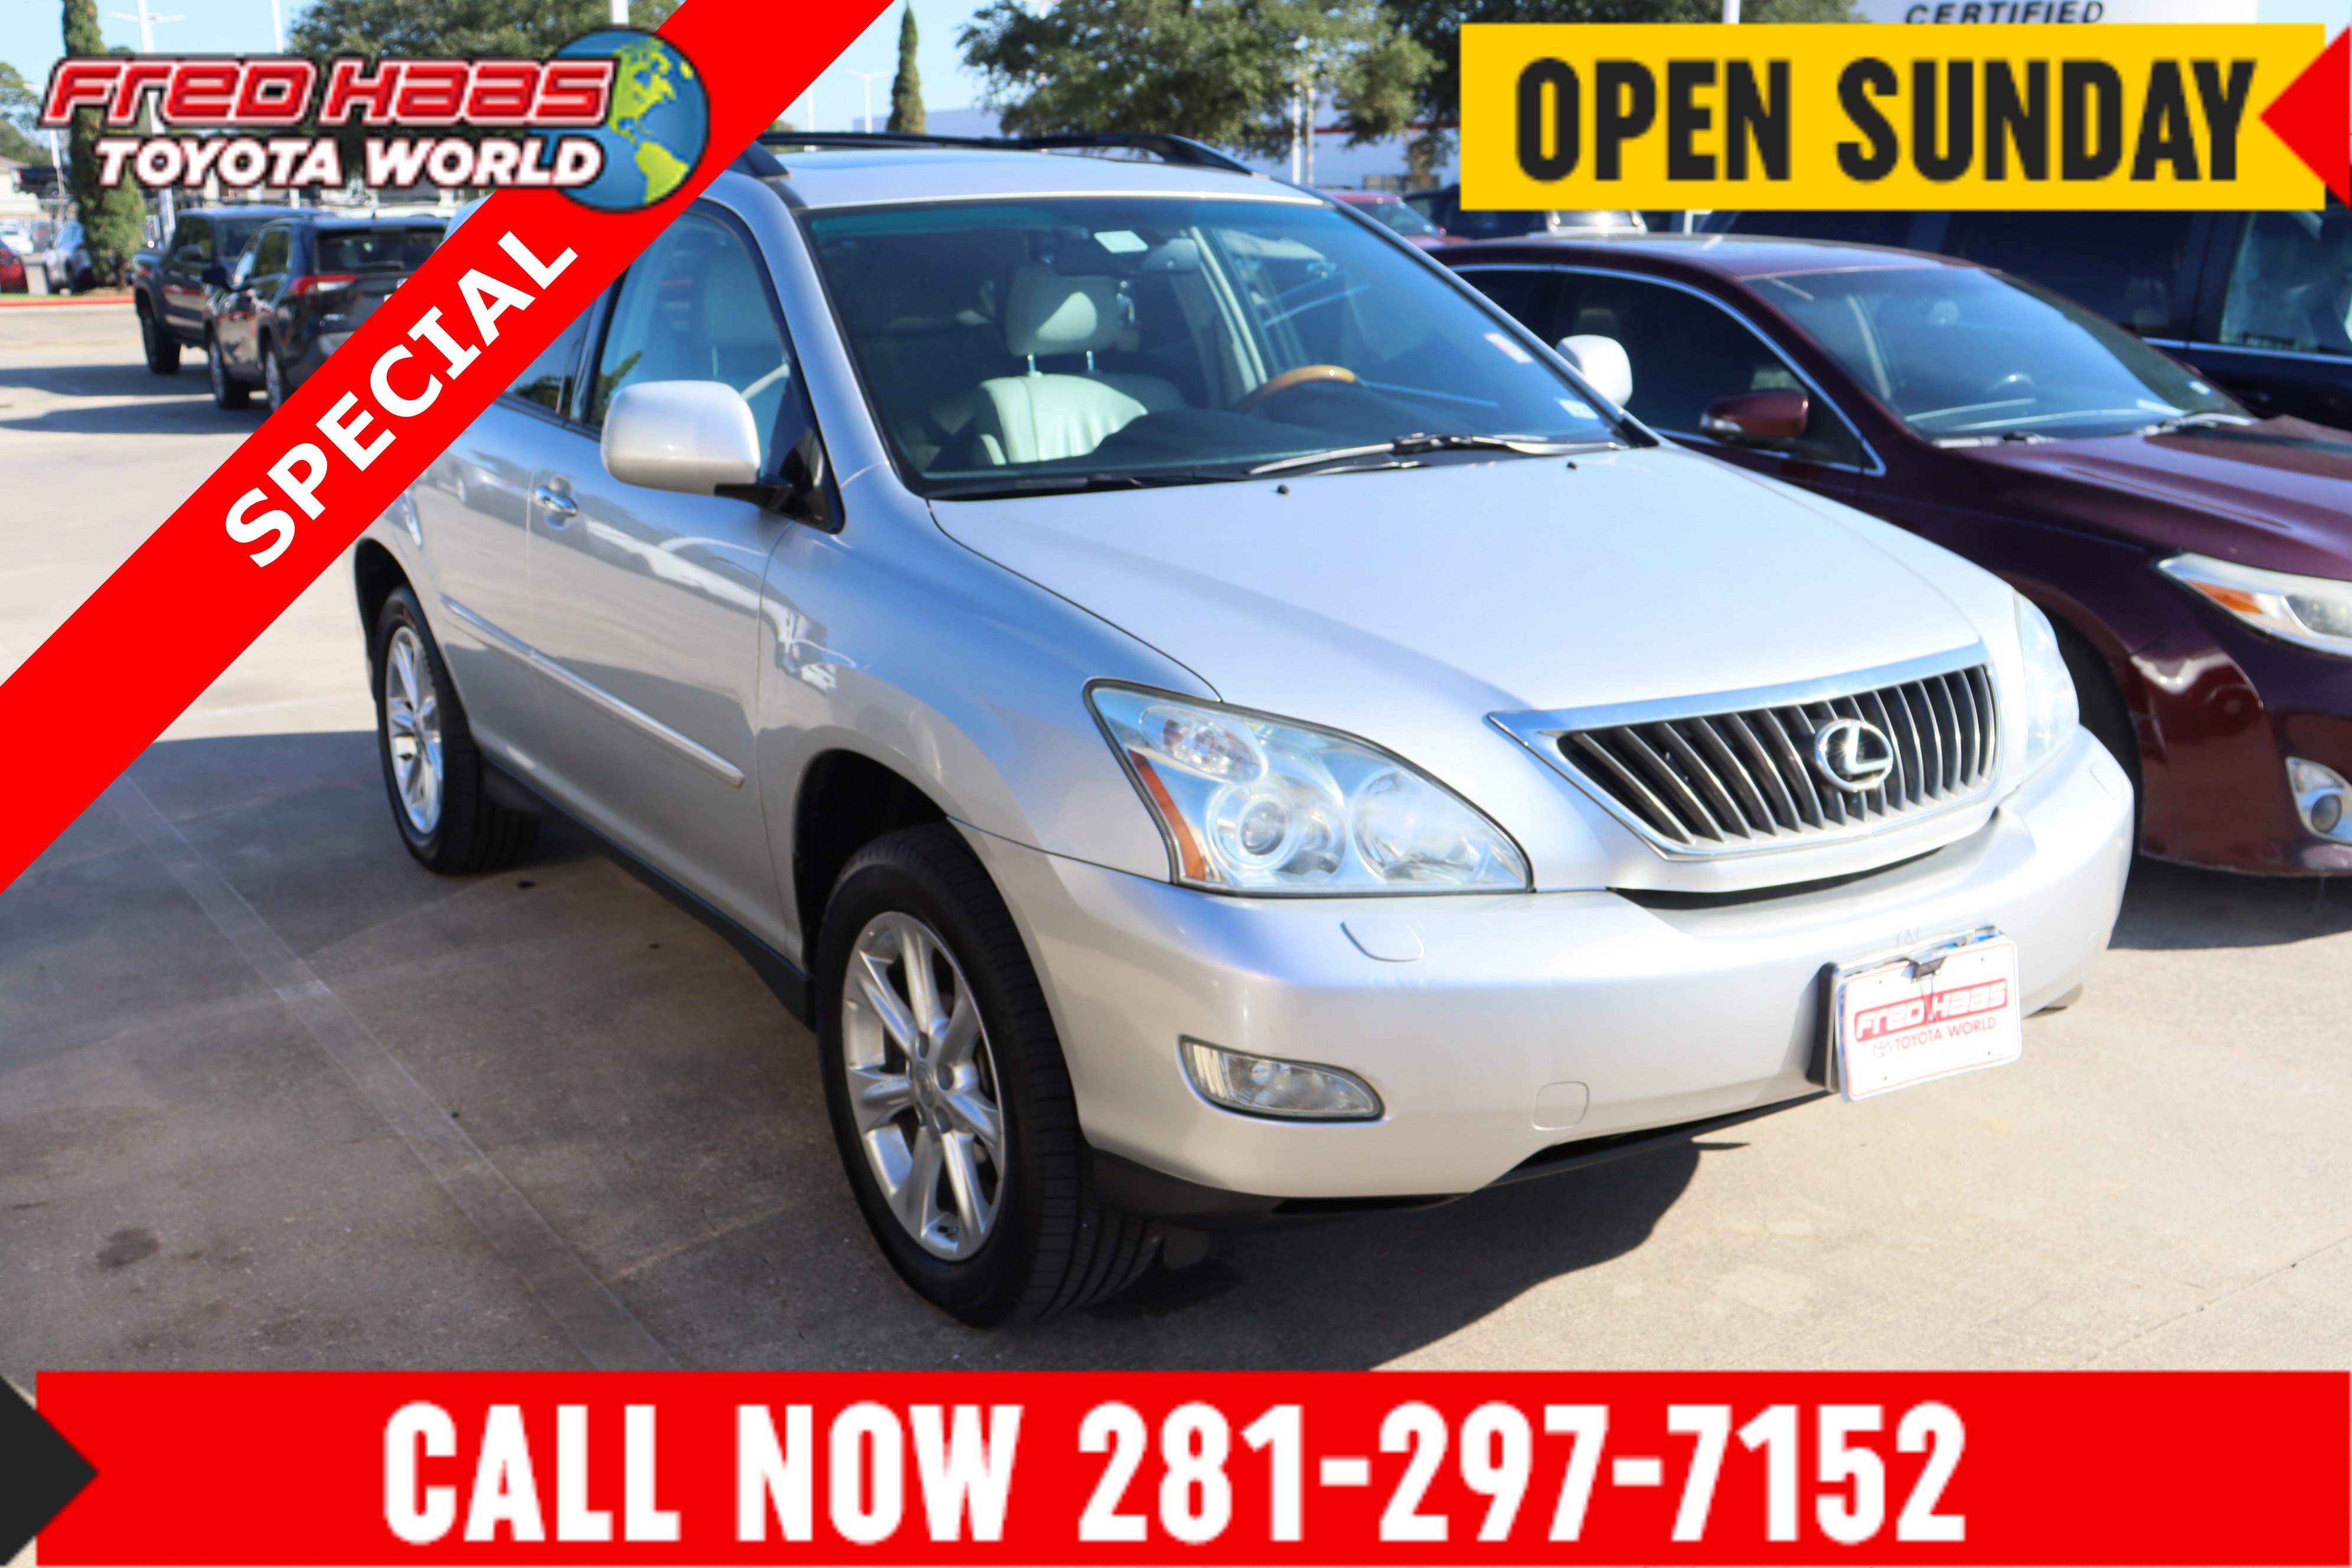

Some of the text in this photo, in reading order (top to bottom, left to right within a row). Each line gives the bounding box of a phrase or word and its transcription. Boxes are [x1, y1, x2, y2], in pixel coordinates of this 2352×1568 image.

[1905, 0, 2105, 24] CERTIFIED
[1894, 1016, 1997, 1050] TOYOTA WORLD
